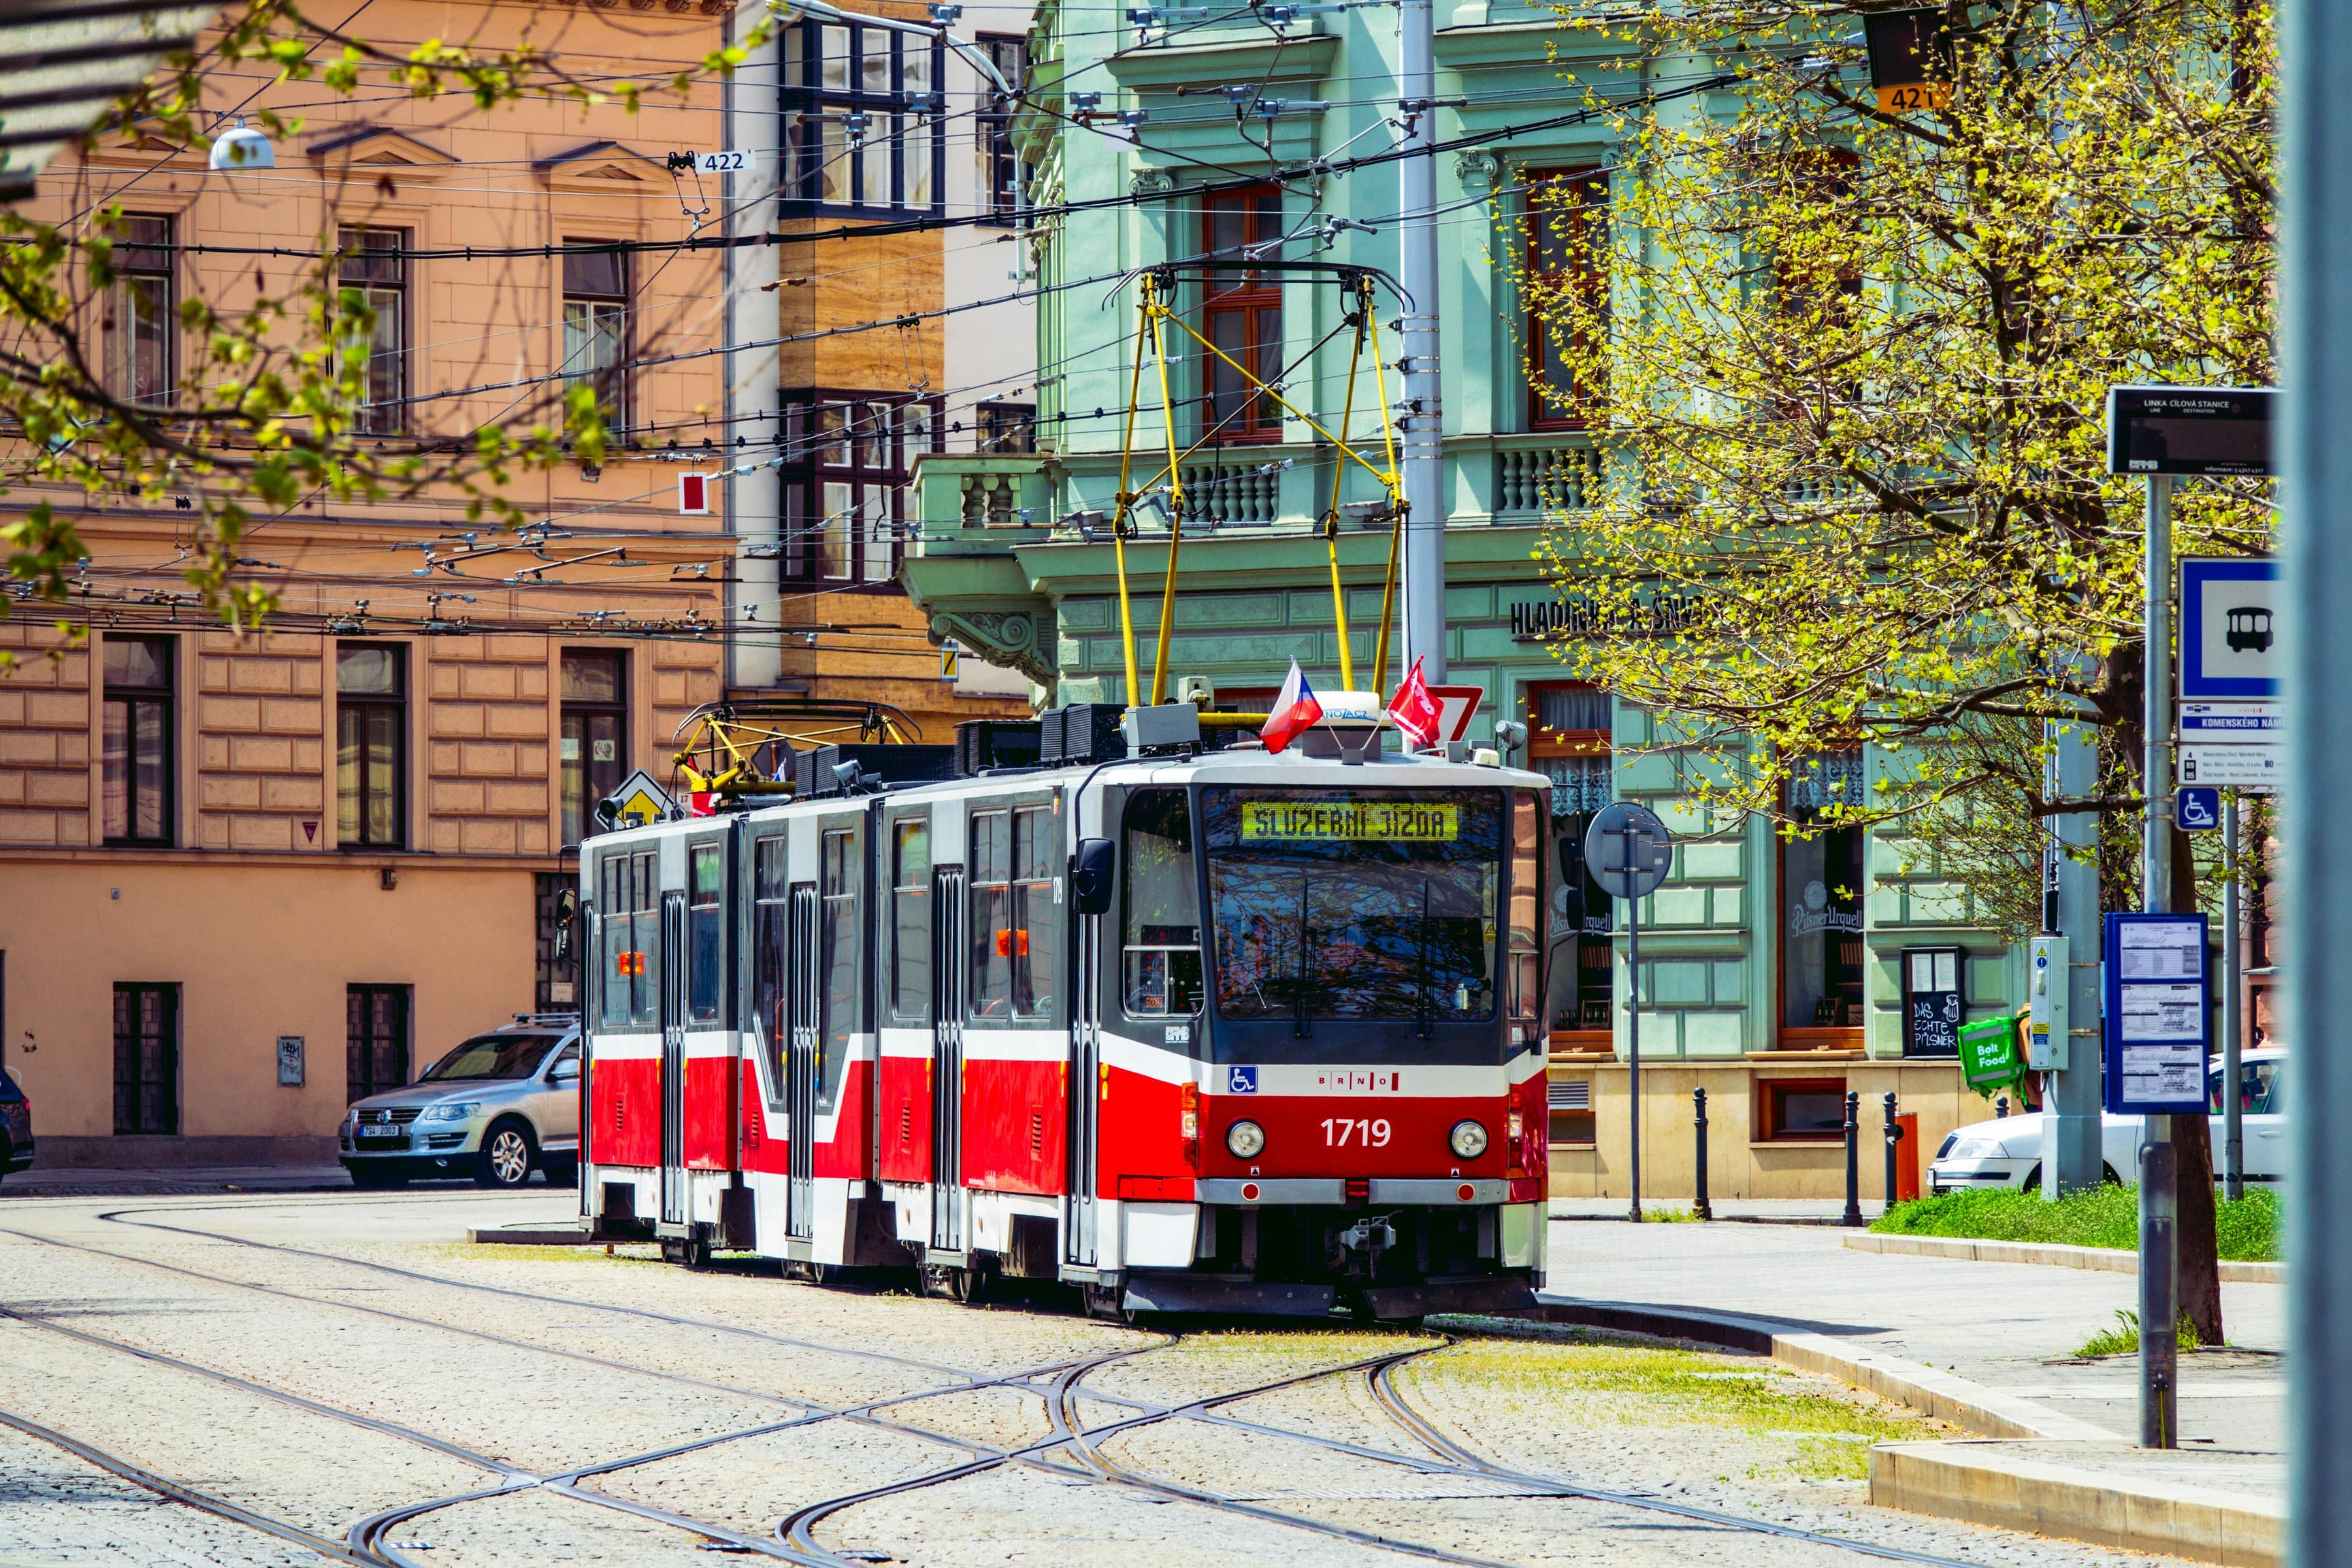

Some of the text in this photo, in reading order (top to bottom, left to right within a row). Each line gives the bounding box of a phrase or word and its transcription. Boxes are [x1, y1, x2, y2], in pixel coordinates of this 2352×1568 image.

[1891, 88, 1933, 110] 421
[705, 153, 743, 170] 422
[2170, 399, 2196, 408] CÍLOVÁ
[2198, 400, 2230, 408] STANICE
[2202, 716, 2259, 728] KOMENSKÉHO
[2264, 760, 2274, 768] 80
[1586, 913, 1611, 936] rquell
[1792, 904, 1862, 937] Pilsner Urquell
[1914, 1002, 1933, 1019] DAS
[1914, 1020, 1949, 1035] ECHTE
[1977, 1043, 1999, 1056] Bolt
[1979, 1054, 2006, 1068] Food
[1320, 1118, 1391, 1147] 1719
